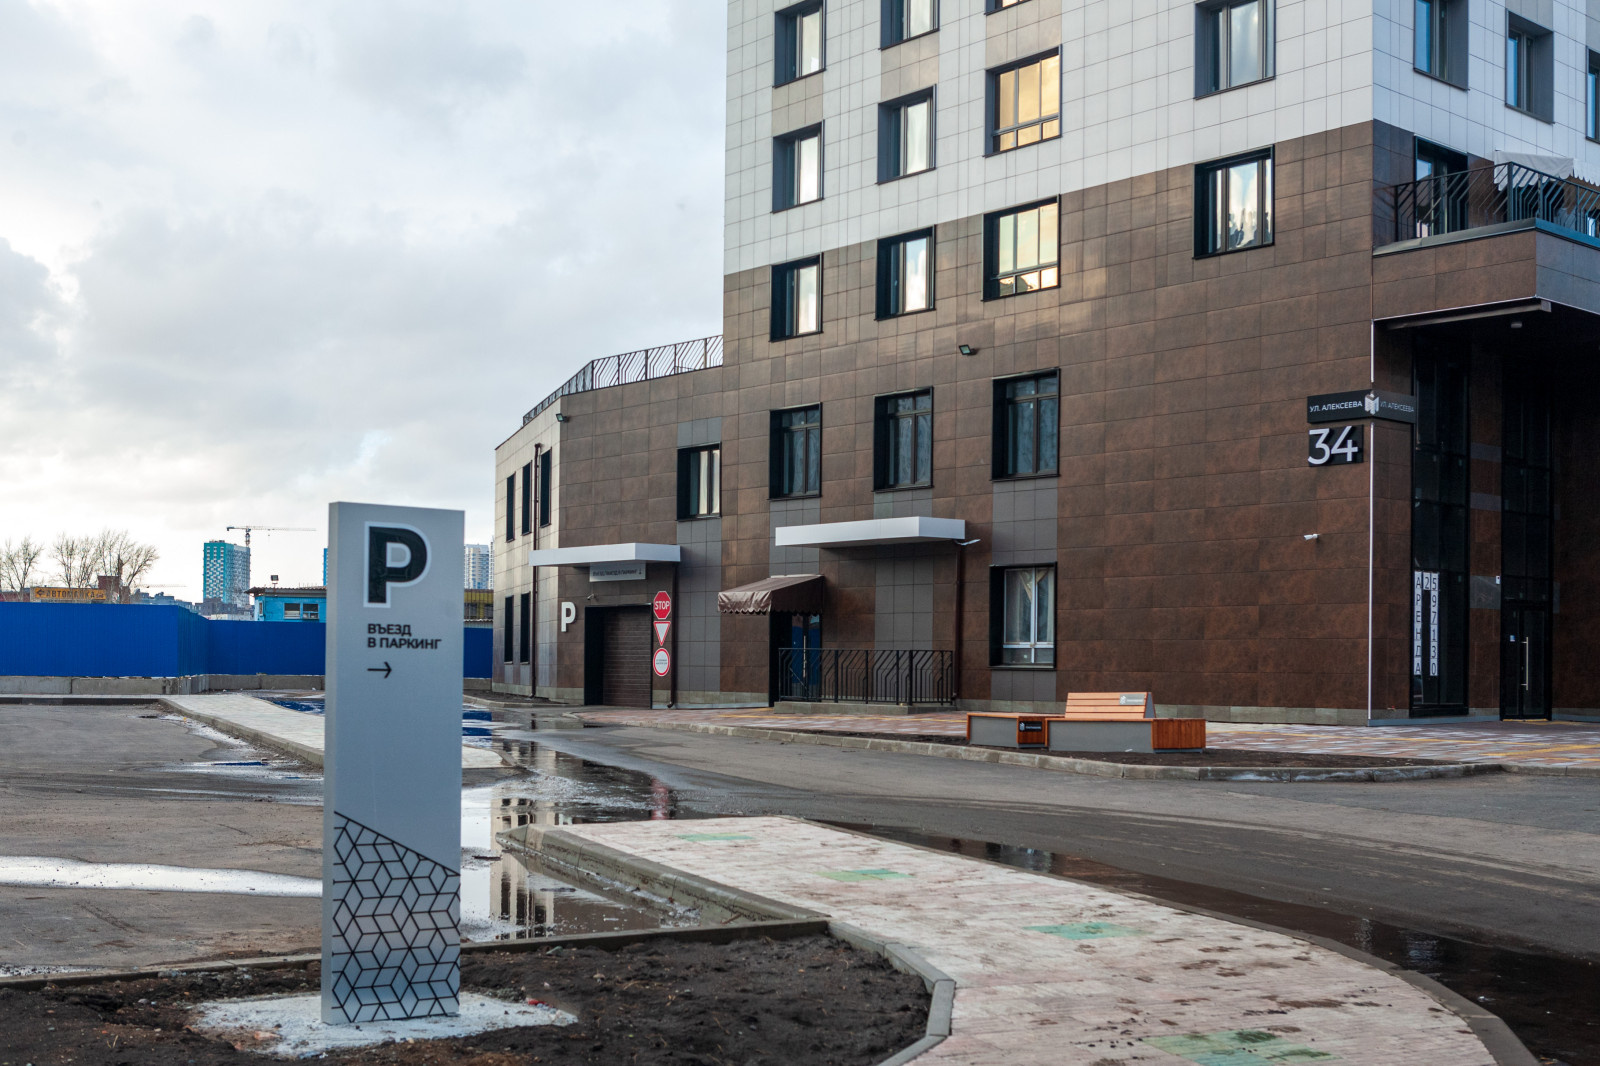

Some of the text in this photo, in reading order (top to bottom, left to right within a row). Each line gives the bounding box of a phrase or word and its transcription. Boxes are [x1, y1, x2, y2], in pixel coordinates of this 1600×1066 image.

[1309, 400, 1363, 413] УЛ. АЛЕКСЕЕВА
[1387, 402, 1415, 412] АЛЕКСЕЕВА
[1307, 425, 1359, 465] 34
[364, 521, 432, 608] P
[654, 601, 671, 610] STOP
[561, 601, 576, 632] P
[367, 623, 412, 637] ВЪЕЗД
[367, 637, 442, 650] В ПАРКИНГ
